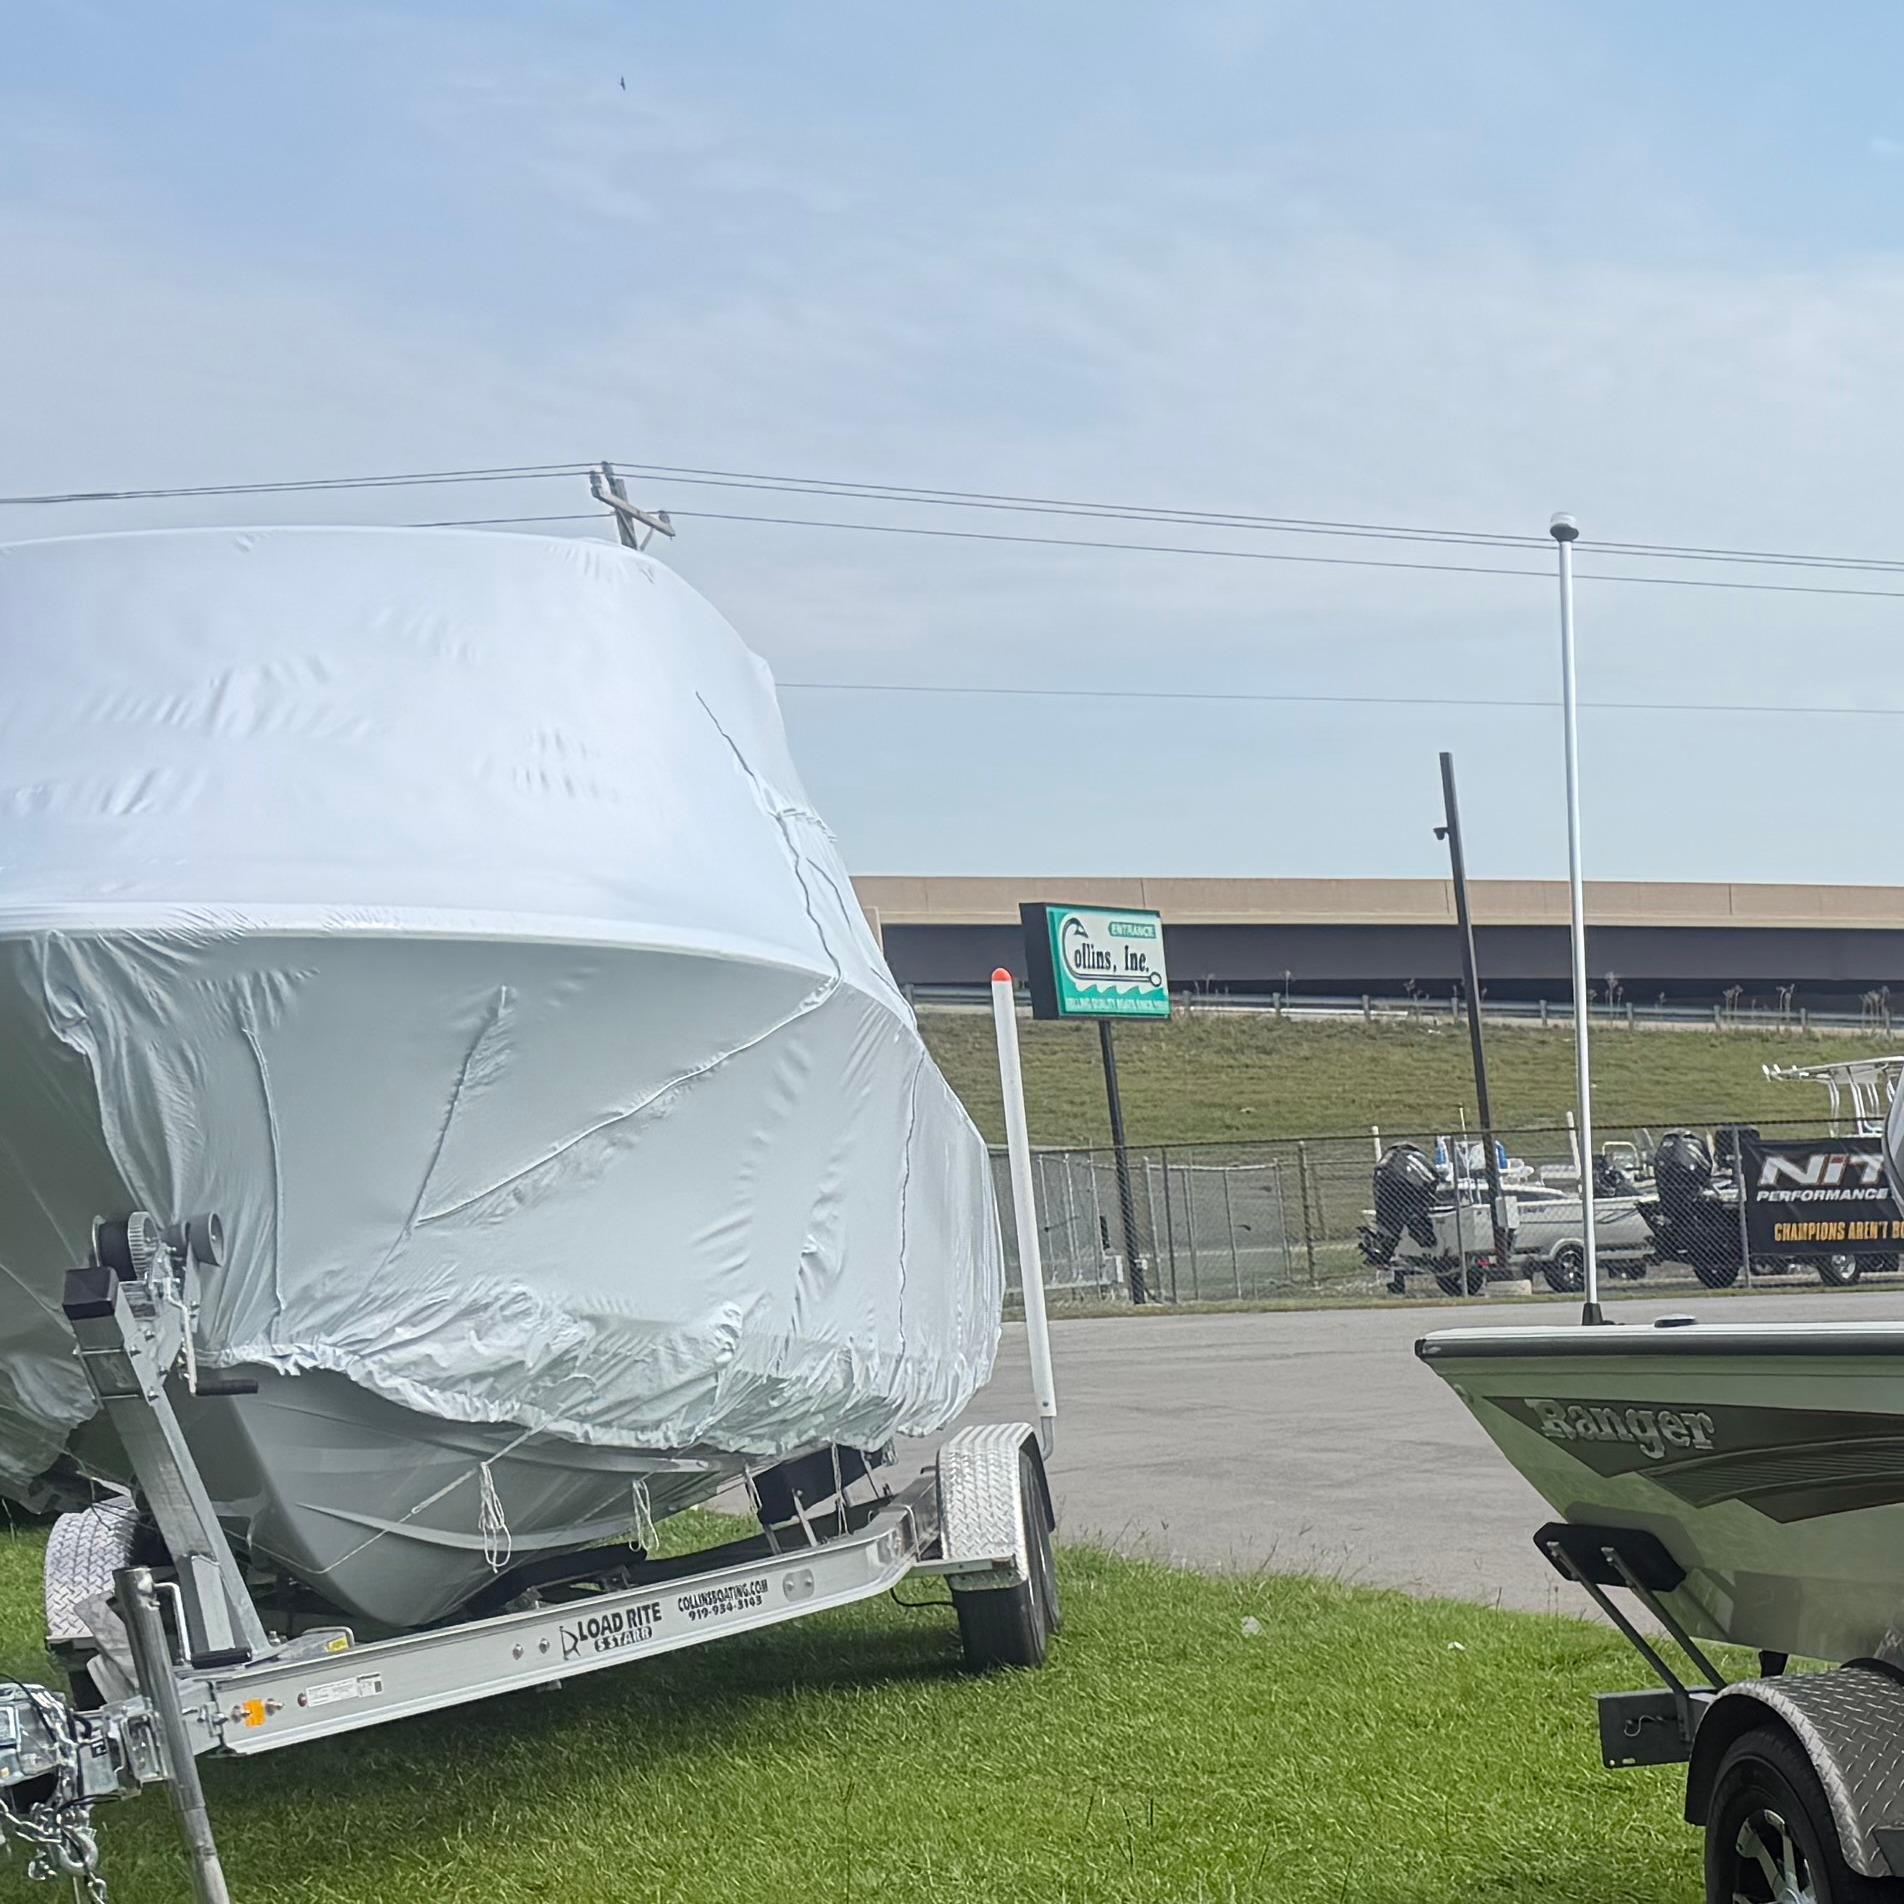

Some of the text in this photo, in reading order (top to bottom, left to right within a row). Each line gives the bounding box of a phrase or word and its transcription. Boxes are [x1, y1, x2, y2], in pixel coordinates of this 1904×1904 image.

[1111, 923, 1155, 938] ENTRANCE
[1124, 945, 1150, 972] Inc.
[1757, 1188, 1888, 1202] PERFORMANCE
[1774, 1222, 1846, 1242] CHAMPIONS
[1848, 1221, 1888, 1240] AREN'T
[1524, 1399, 1714, 1459] Ranger
[578, 1602, 662, 1641] LOAD RITE
